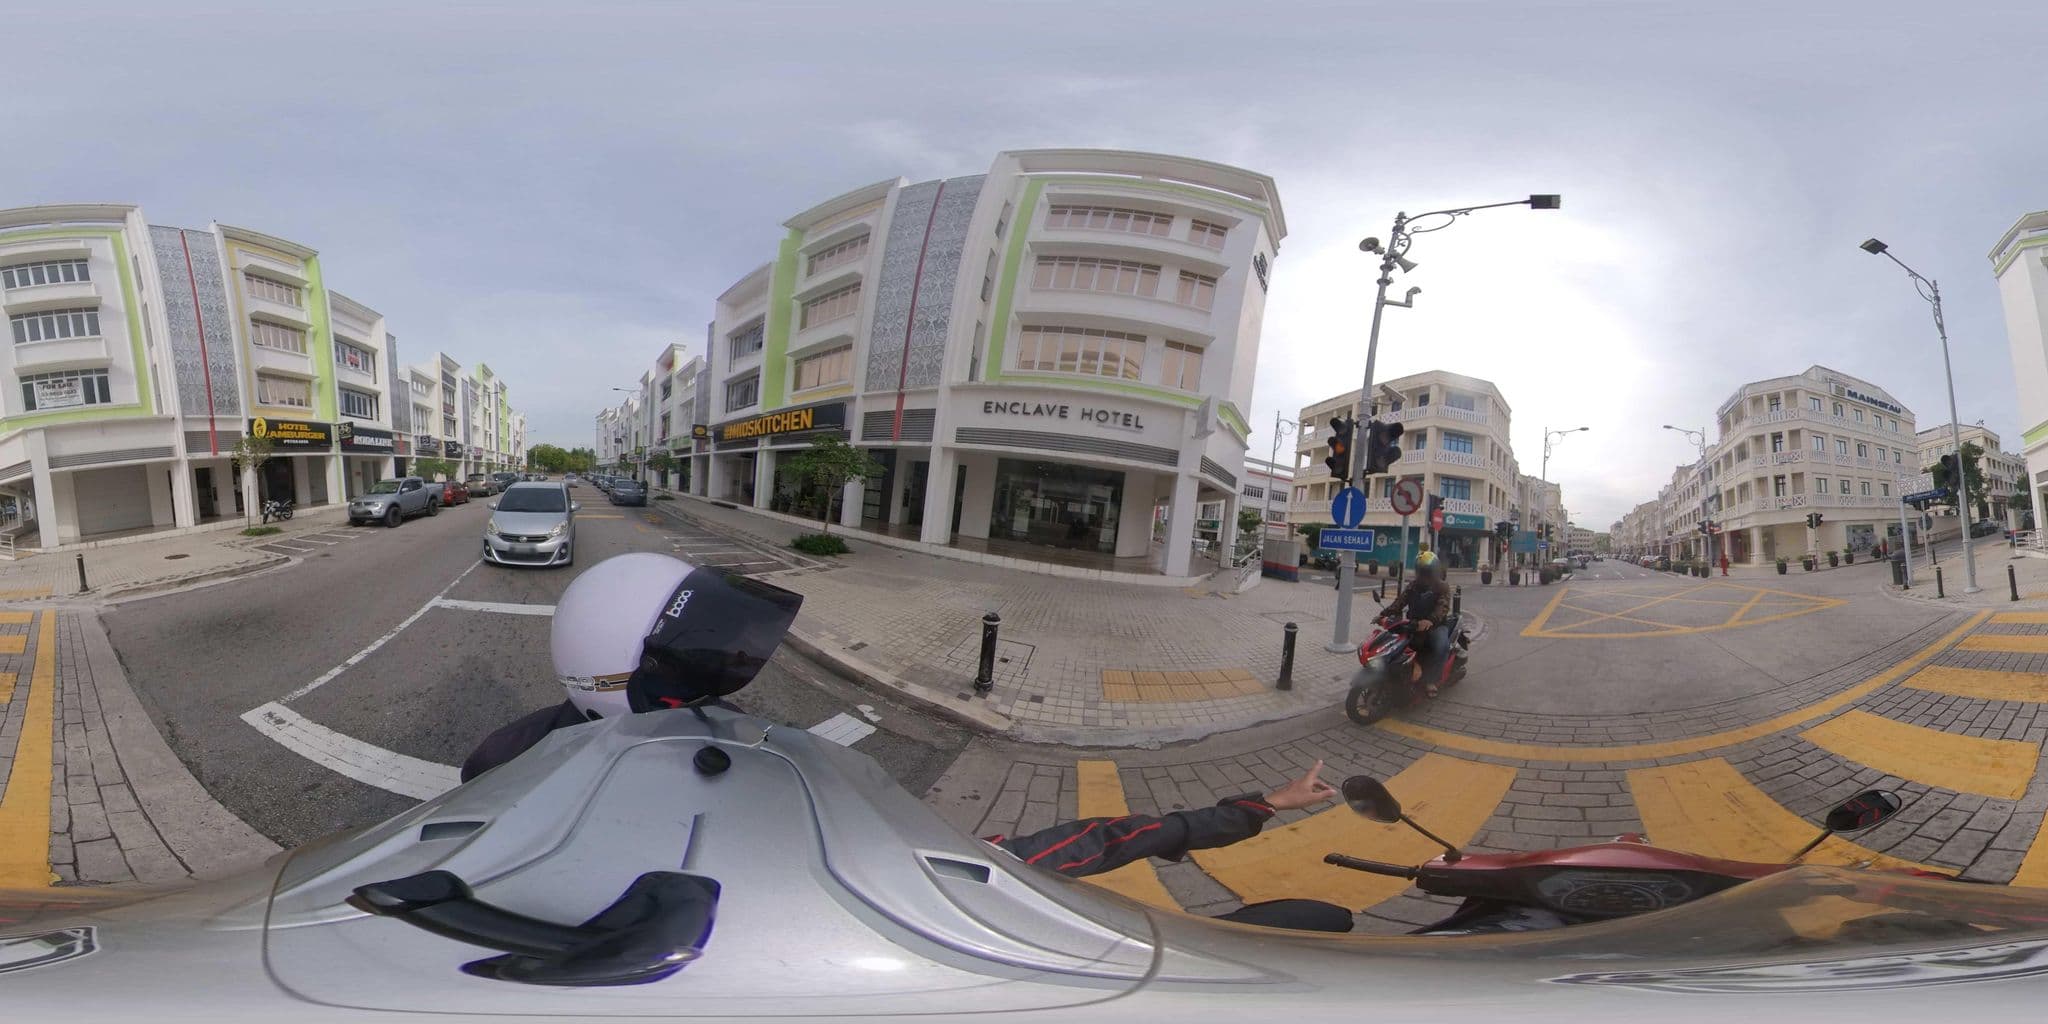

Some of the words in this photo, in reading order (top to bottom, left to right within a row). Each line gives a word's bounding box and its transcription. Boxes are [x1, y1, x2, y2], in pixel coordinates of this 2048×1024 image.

[983, 401, 1069, 419] ENCLAVE
[1081, 407, 1144, 430] HOTEL
[278, 423, 311, 431] HOTEL
[1323, 535, 1342, 544] JALAN
[1343, 535, 1370, 545] SEHALA
